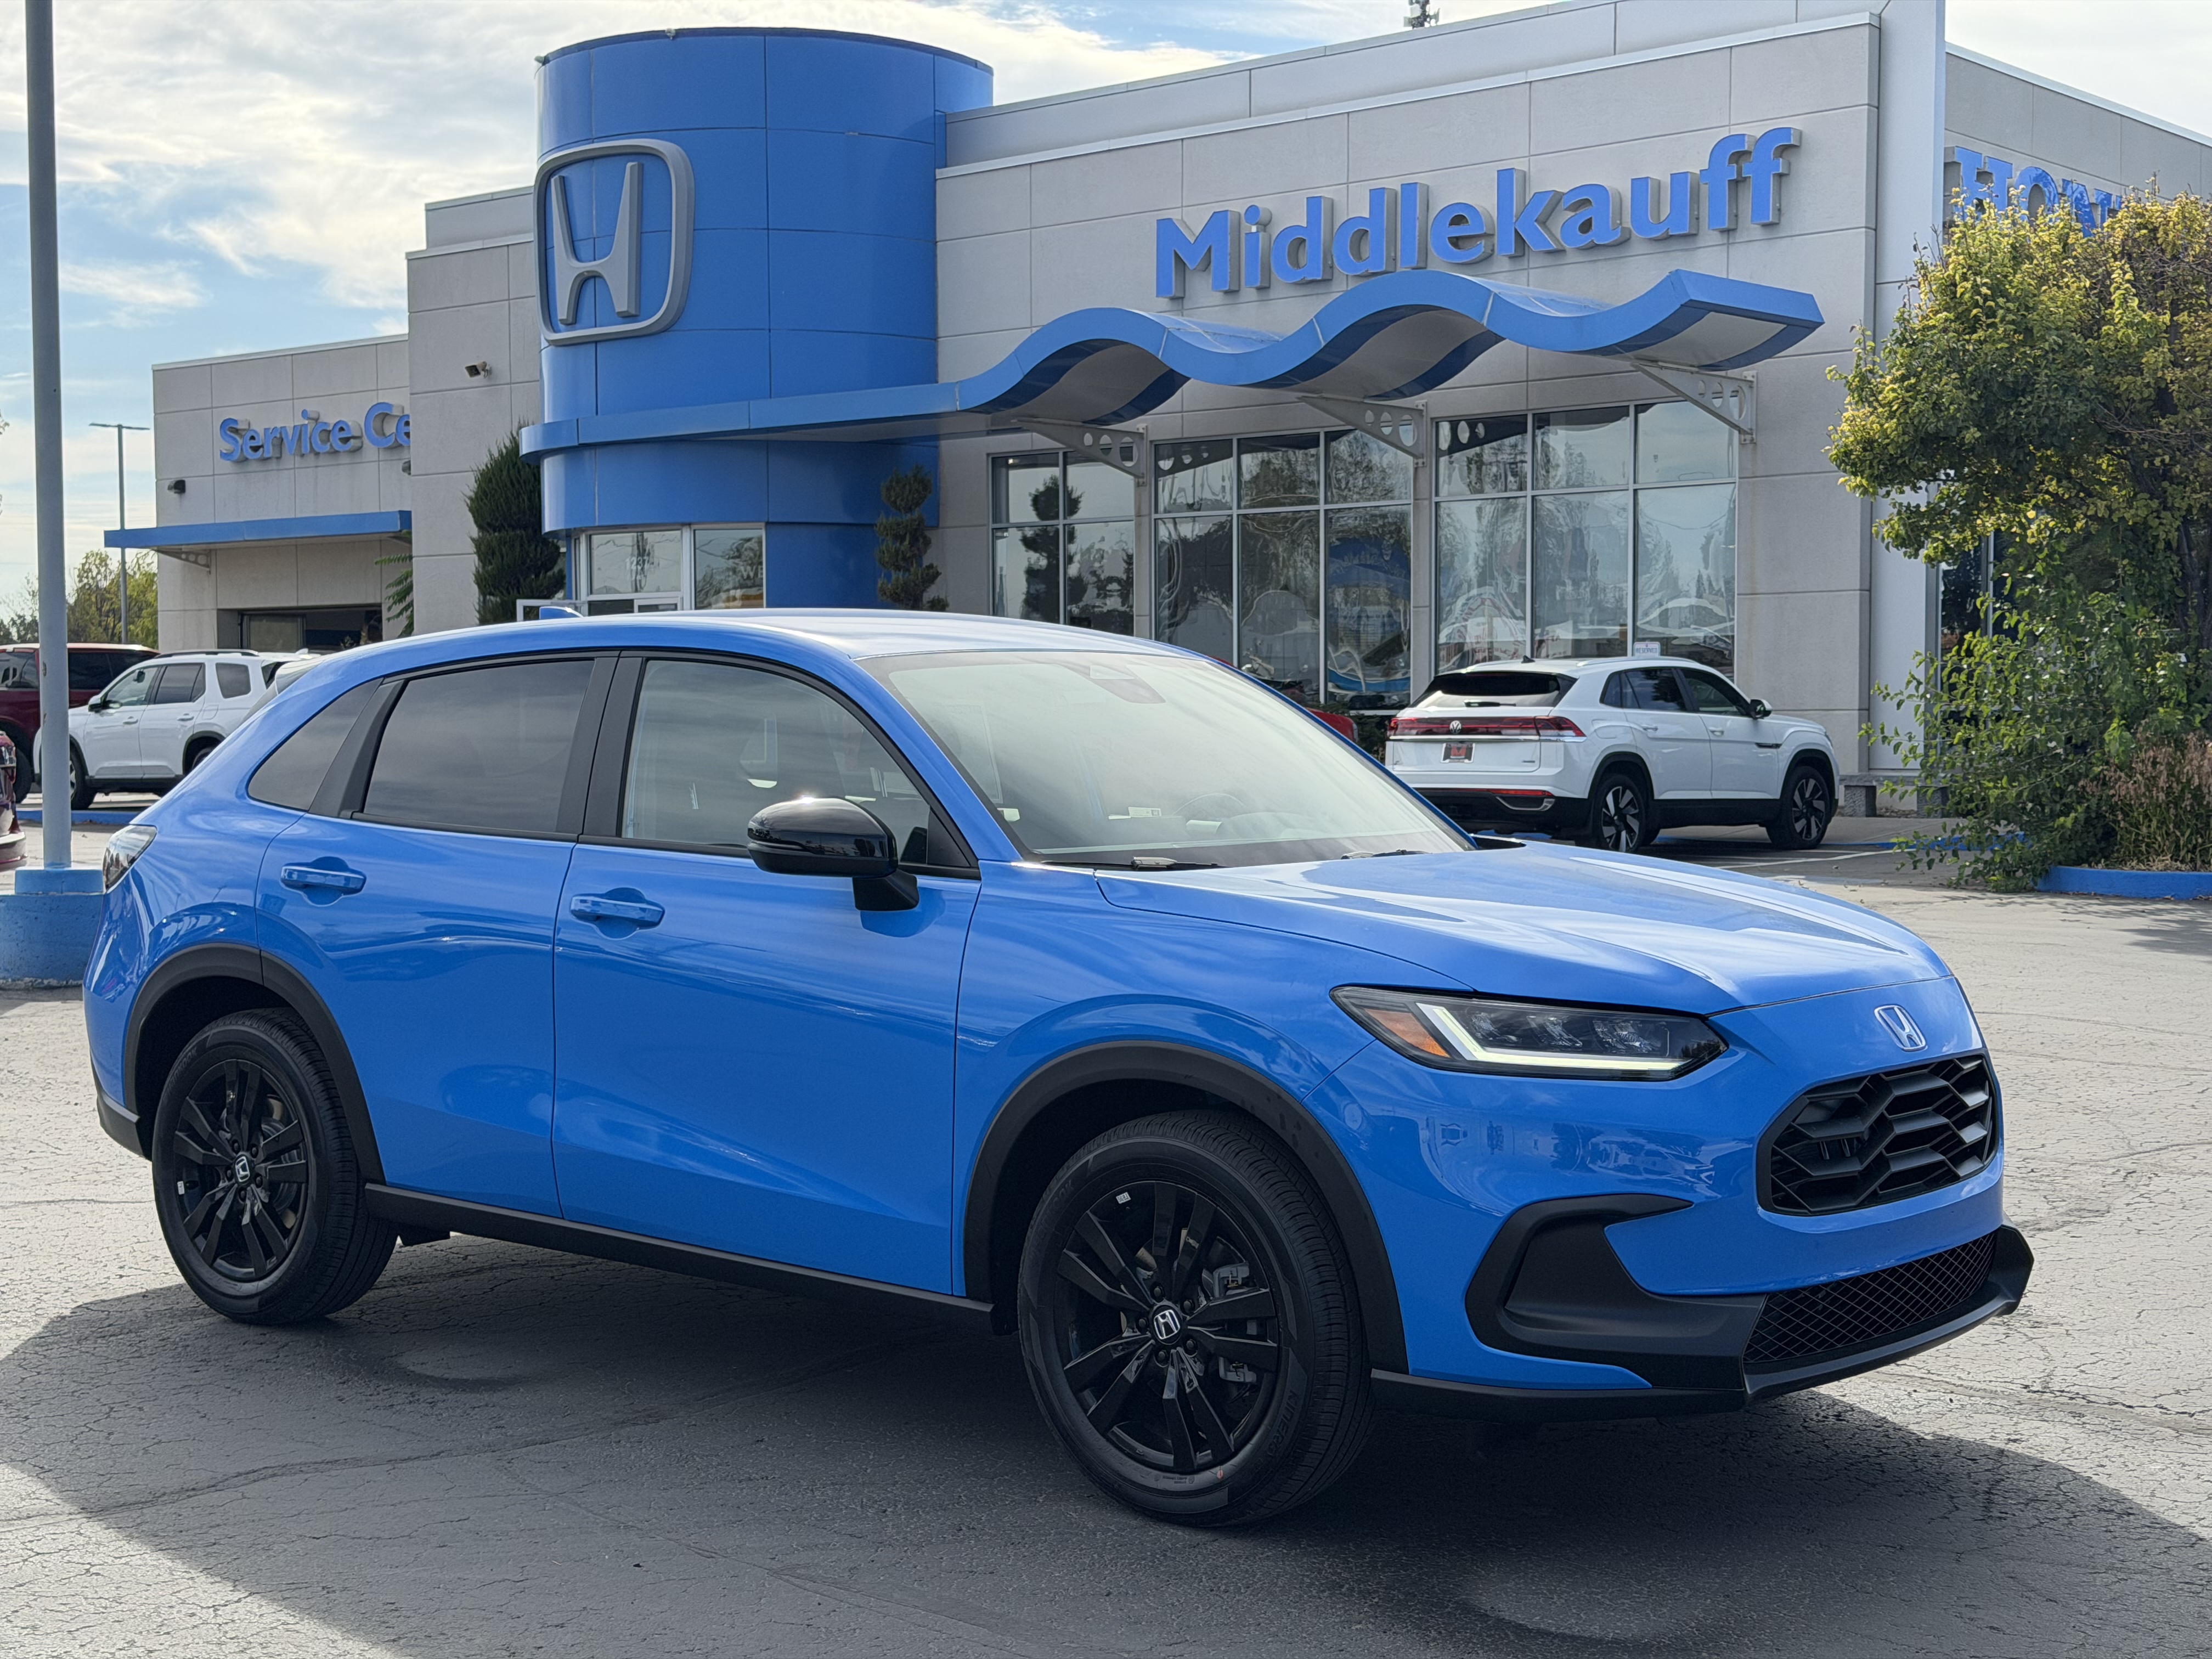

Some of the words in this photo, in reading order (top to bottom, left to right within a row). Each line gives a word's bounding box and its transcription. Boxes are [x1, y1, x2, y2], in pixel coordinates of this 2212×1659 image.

[1155, 127, 1801, 300] Middlekauff
[1955, 145, 2122, 238] HON
[220, 409, 359, 462] Service
